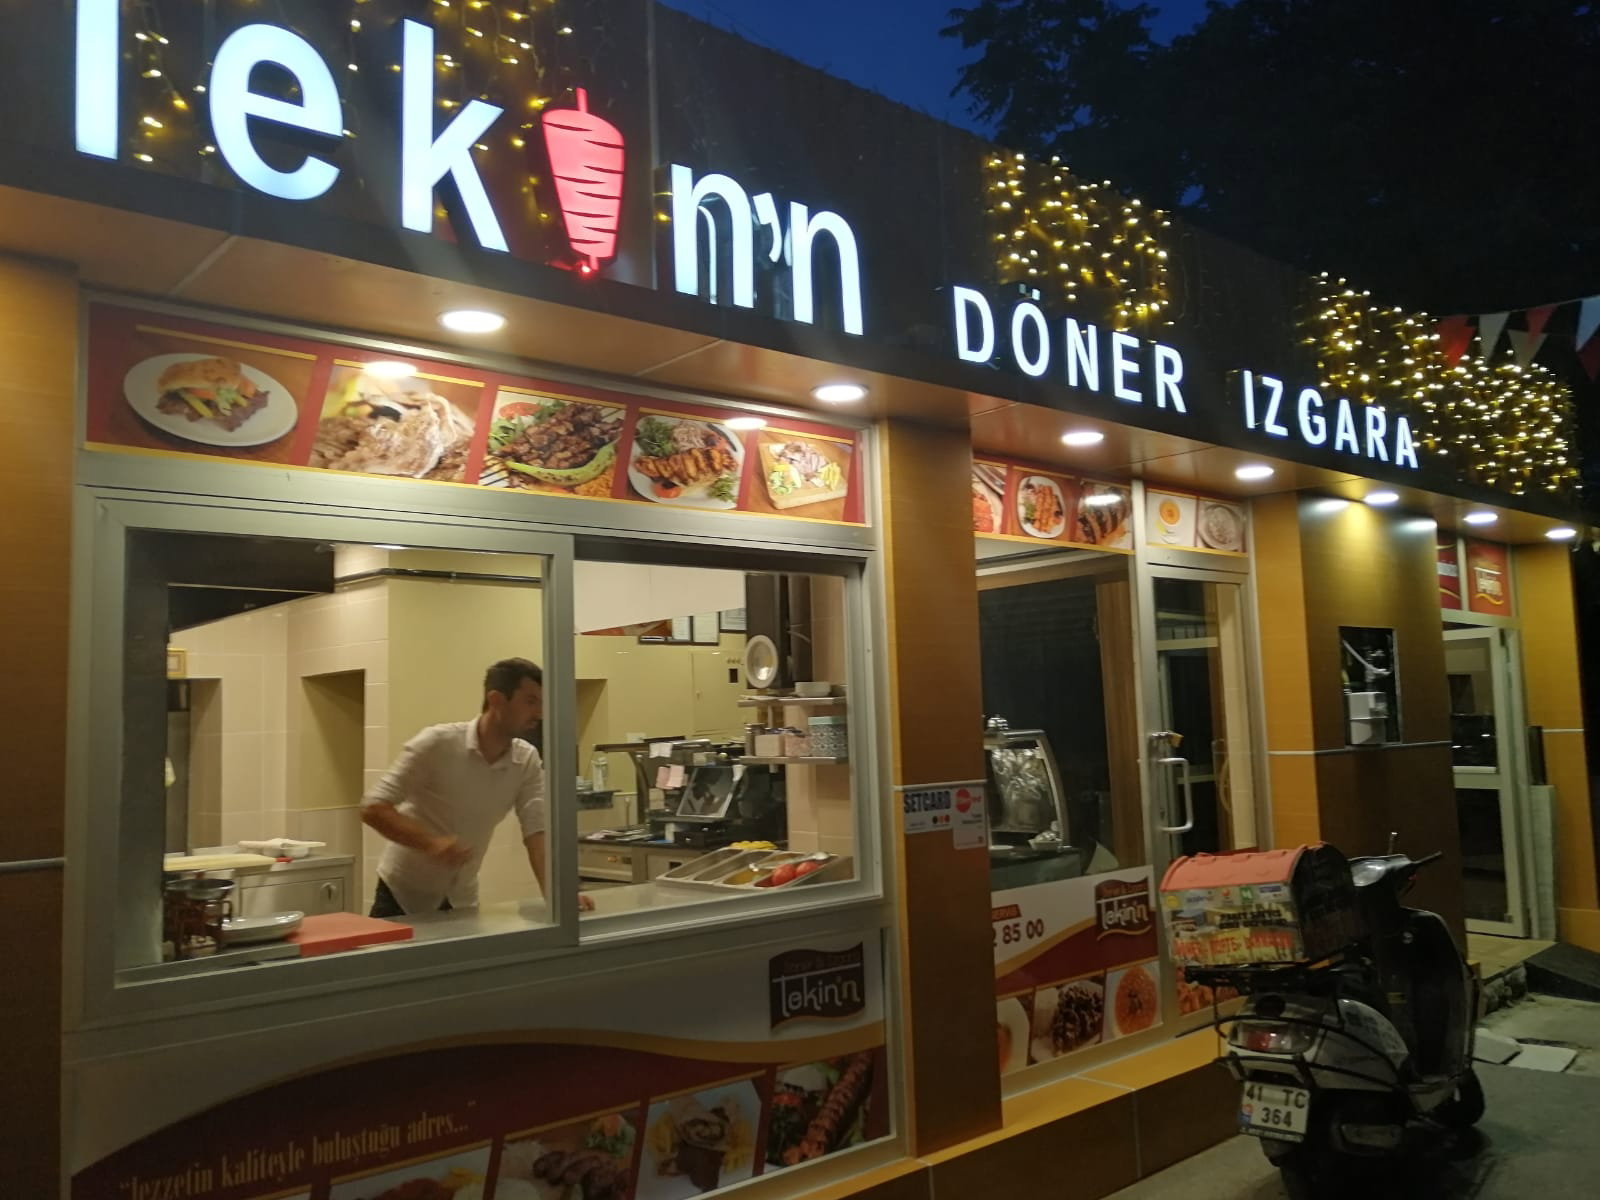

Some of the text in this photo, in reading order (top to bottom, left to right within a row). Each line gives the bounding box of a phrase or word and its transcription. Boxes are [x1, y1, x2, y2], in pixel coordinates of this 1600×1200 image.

[953, 282, 1187, 413] DÖNER
[1242, 369, 1419, 469] IZGARA
[1002, 925, 1021, 944] 85
[1026, 918, 1045, 940] 00
[772, 961, 861, 1018] Tekin'n
[1246, 1084, 1306, 1110] 41 TC
[1261, 1106, 1293, 1128] 364
[221, 1140, 305, 1187] kaliteyle
